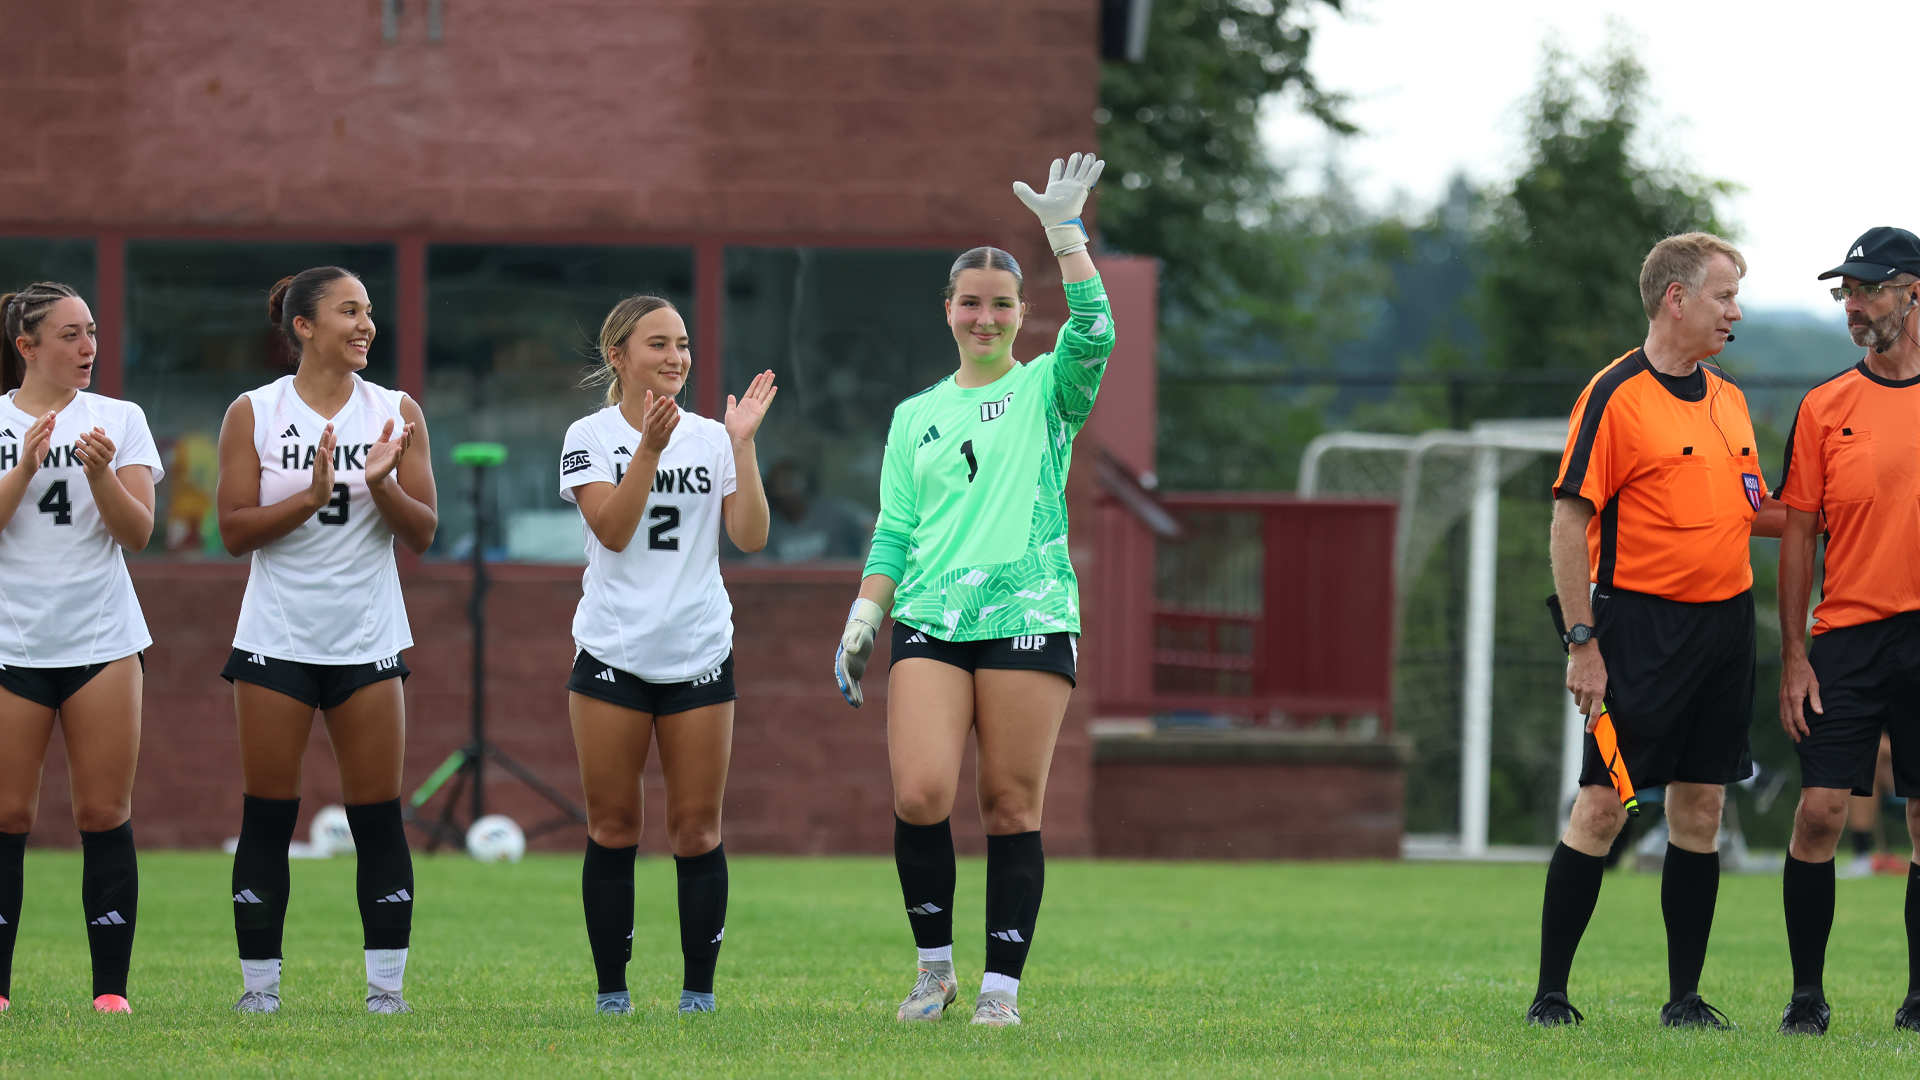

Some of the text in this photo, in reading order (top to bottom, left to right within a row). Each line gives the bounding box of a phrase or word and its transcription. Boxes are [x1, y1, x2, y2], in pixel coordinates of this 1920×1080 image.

[282, 443, 374, 471] HAK
[562, 452, 592, 471] PSAC
[960, 439, 978, 483] 1
[615, 462, 712, 494] HWKS
[37, 479, 72, 526] 4
[317, 482, 350, 526] 3
[648, 504, 680, 551] 2
[1011, 634, 1047, 651] IUP
[374, 654, 399, 673] IUP
